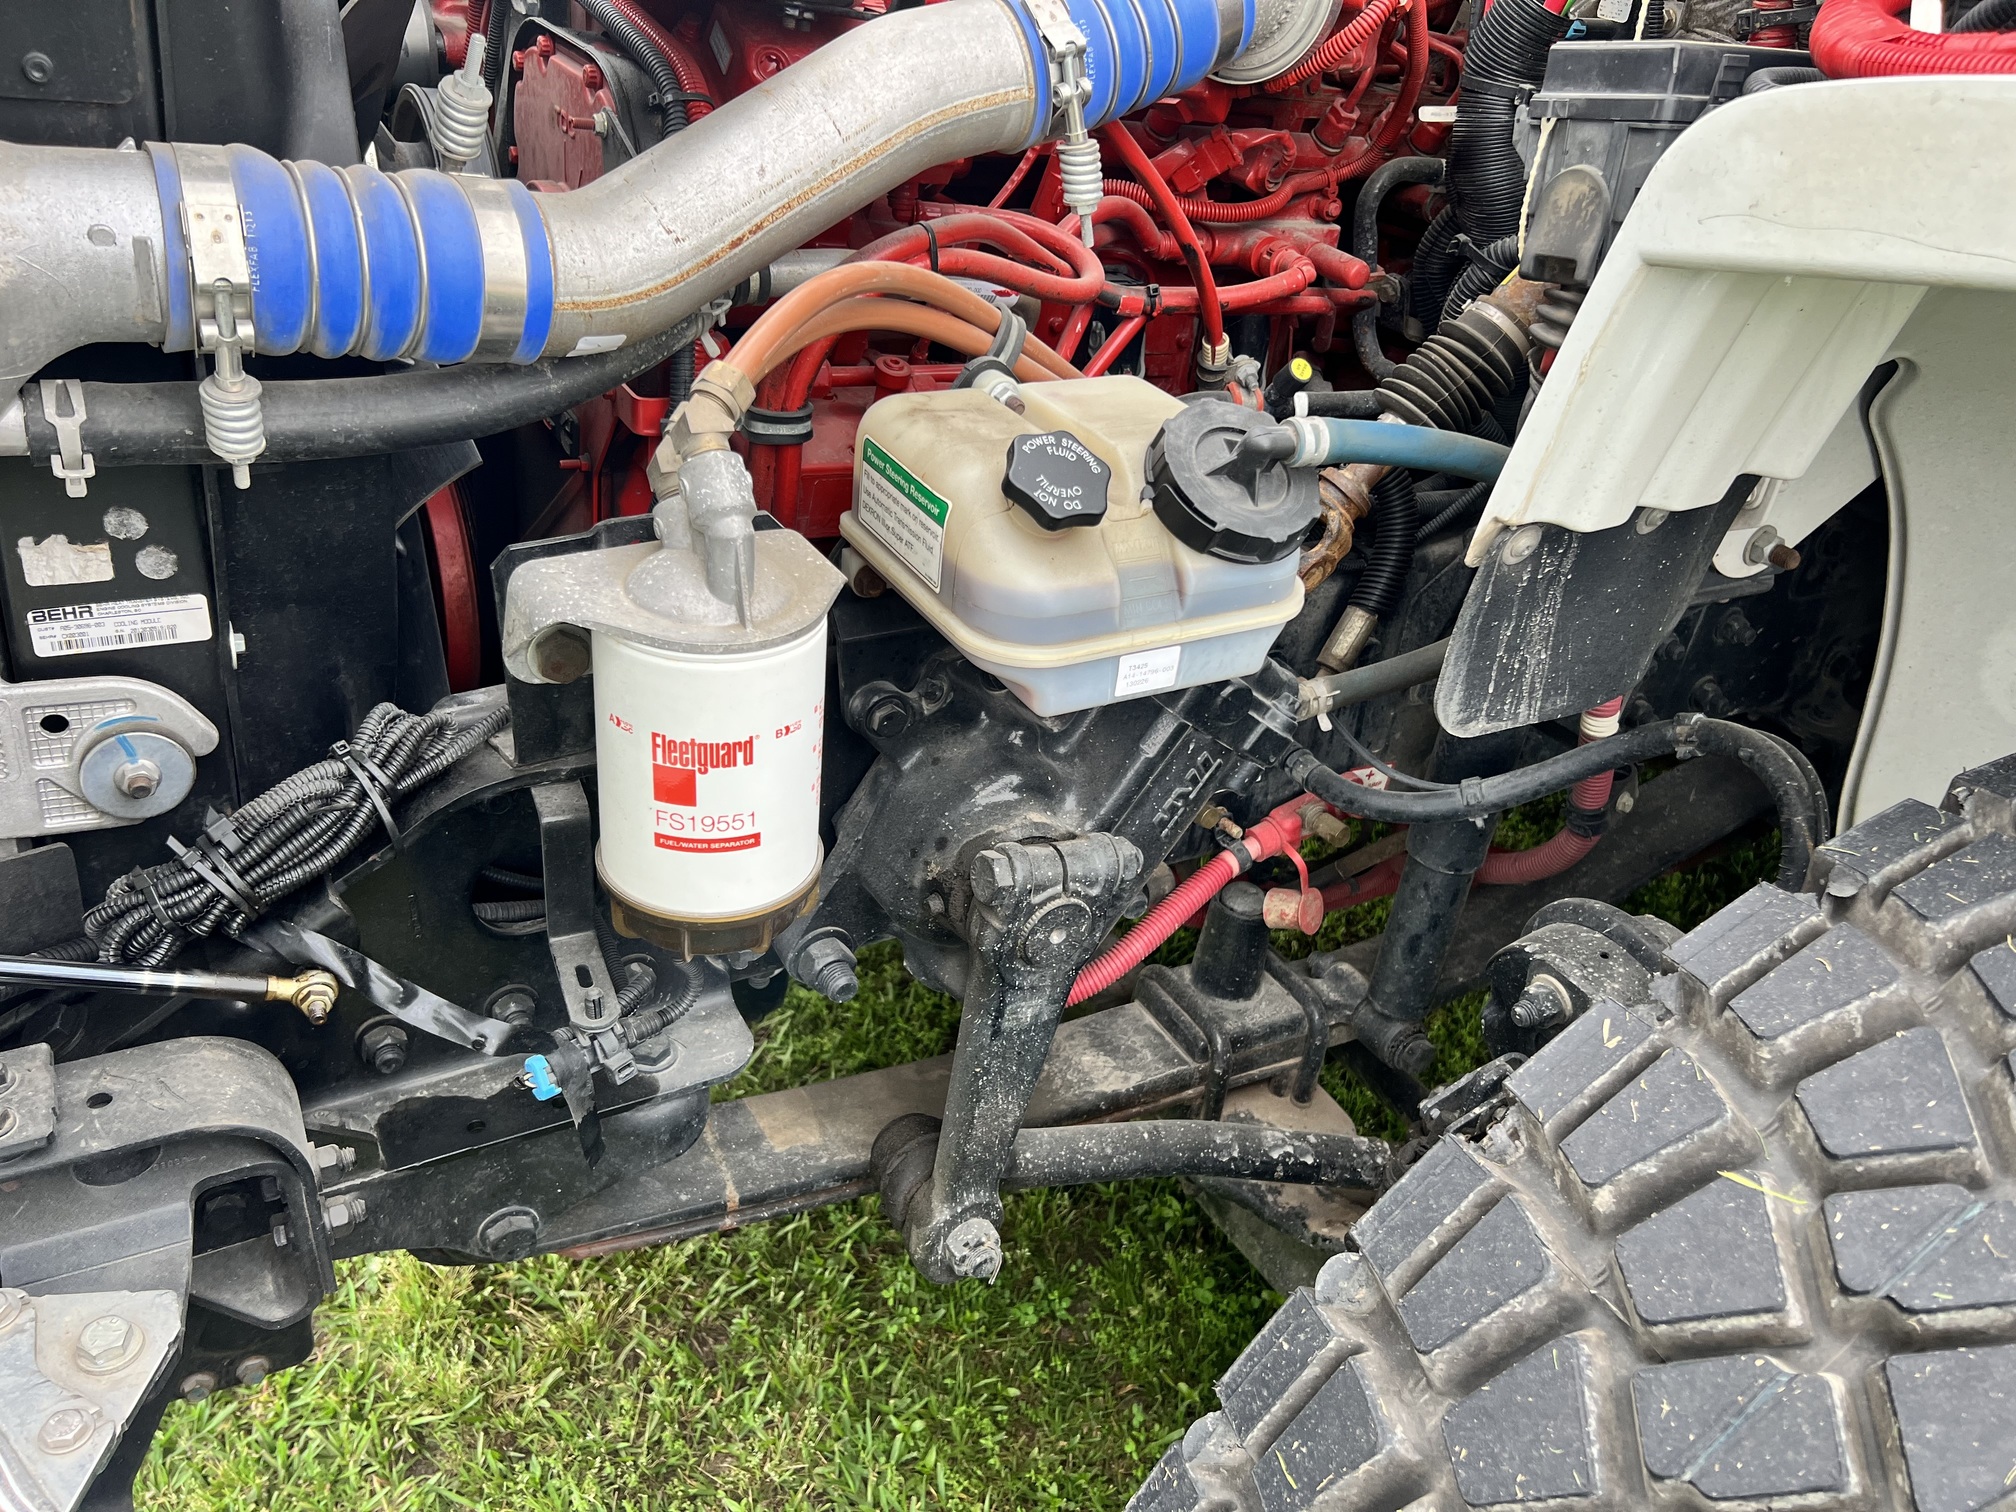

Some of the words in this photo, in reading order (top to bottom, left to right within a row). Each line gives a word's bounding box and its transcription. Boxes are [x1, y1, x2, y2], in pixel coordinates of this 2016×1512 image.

[247, 246, 260, 293] FLEXFAB
[1022, 436, 1056, 454] POWER
[1061, 438, 1101, 474] STEERING
[1046, 446, 1077, 462] FLUID
[867, 448, 885, 470] Power
[886, 463, 909, 494] Steering
[910, 485, 940, 517] Reservoir
[1035, 475, 1082, 498] OVERFILL
[1033, 489, 1058, 507] NOT
[1063, 500, 1082, 511] DO
[872, 493, 893, 518] Automatic
[894, 511, 921, 543] Transmission
[31, 605, 94, 622] BEHR
[609, 713, 615, 724] A
[775, 729, 783, 739] B
[651, 732, 754, 775] Fleetguard
[656, 810, 755, 833] FS19551
[659, 838, 709, 849] FUEL/WATER
[710, 838, 755, 849] SEPARATOR
